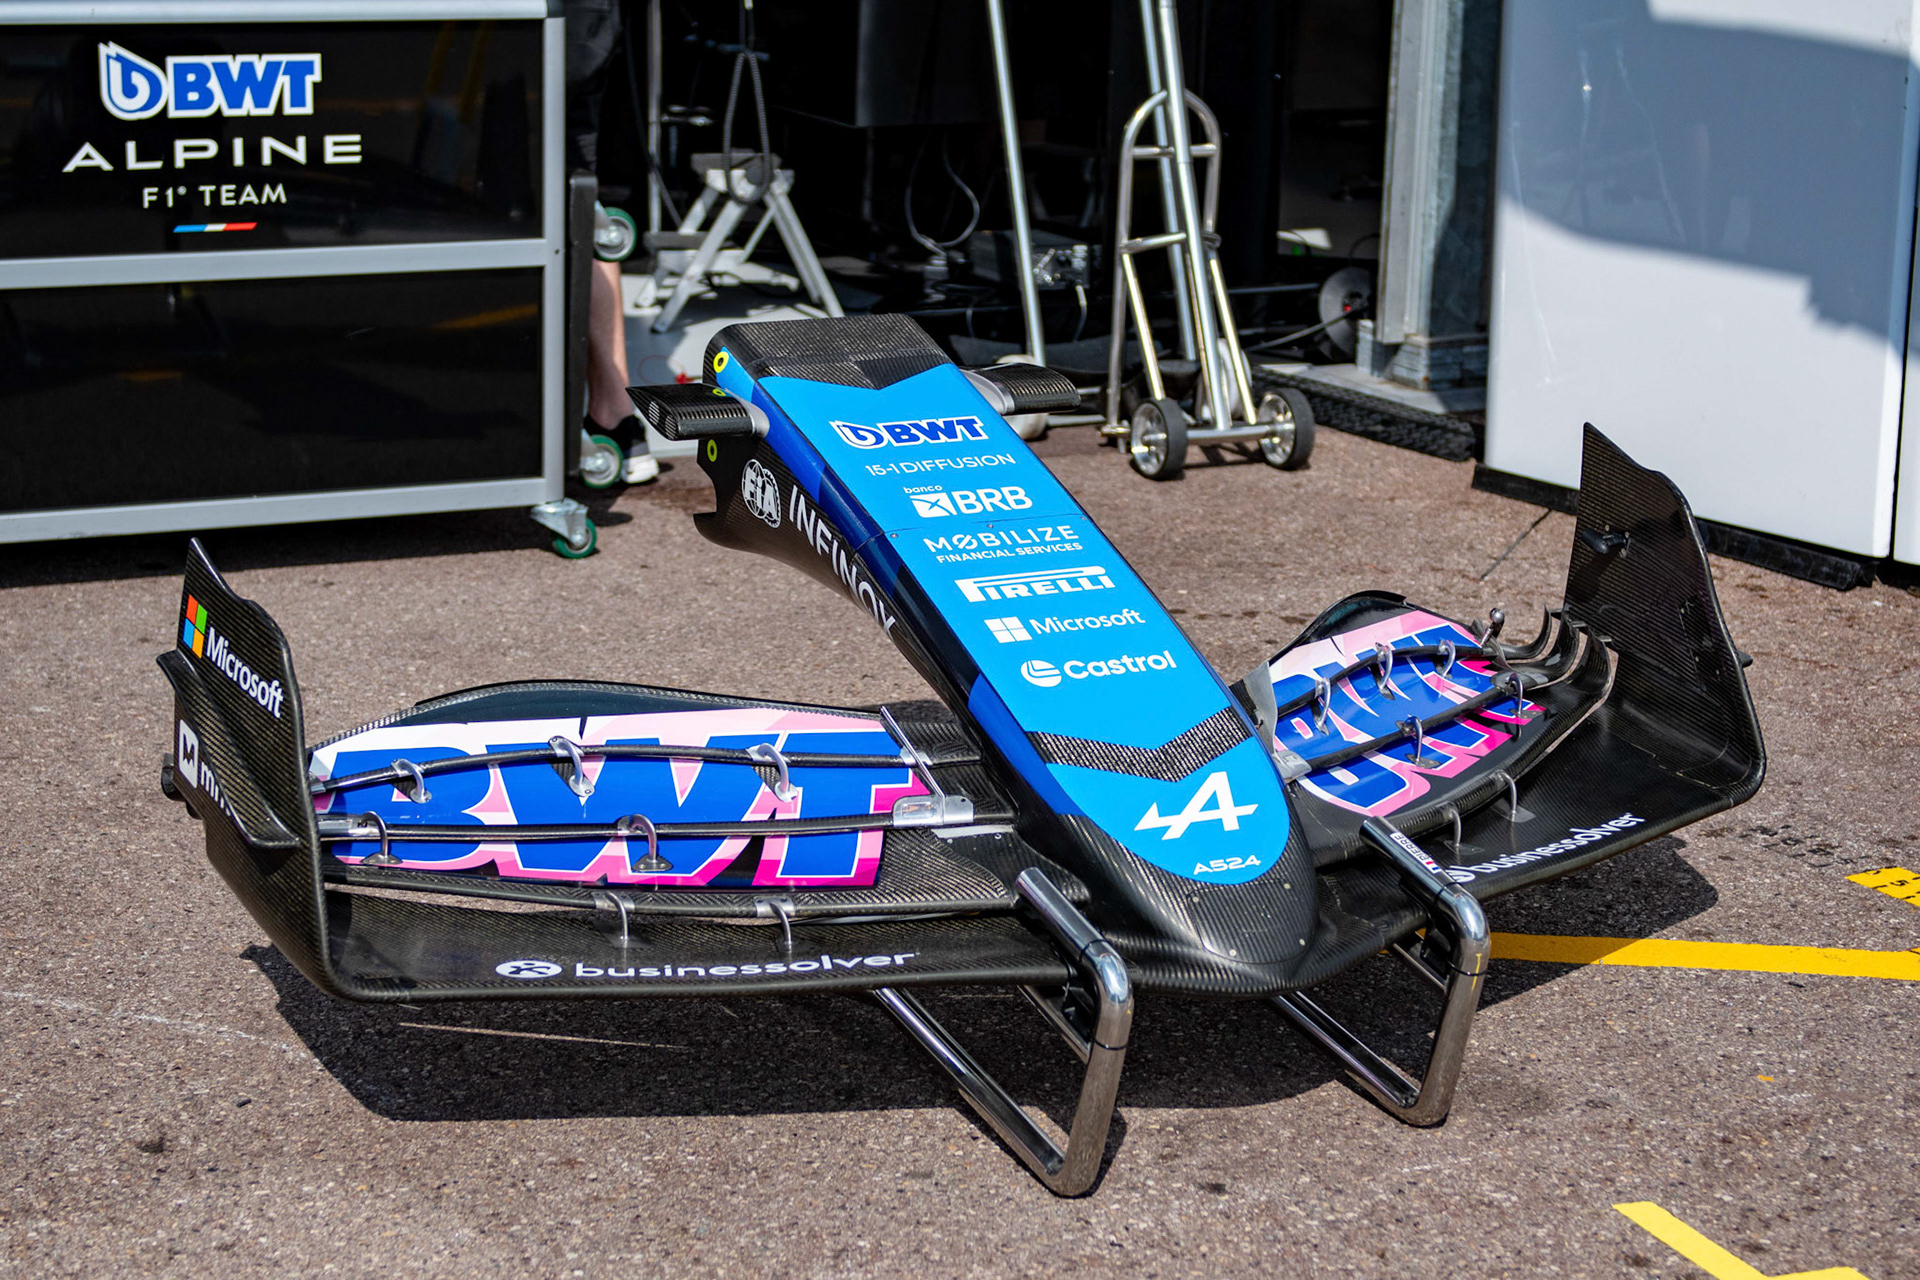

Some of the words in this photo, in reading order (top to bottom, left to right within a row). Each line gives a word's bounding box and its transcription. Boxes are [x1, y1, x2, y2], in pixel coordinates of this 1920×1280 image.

[166, 53, 321, 118] BWT
[62, 134, 362, 172] ALPINE
[198, 183, 287, 206] TEAM
[881, 416, 989, 447] BWT
[899, 453, 1016, 474] DIFFUSION
[903, 485, 943, 494] banco
[951, 486, 1033, 515] BRB
[936, 545, 1016, 563] FINANCIAL
[1015, 542, 1083, 556] SERVICES
[954, 565, 1116, 603] PIRELLI
[1029, 609, 1146, 635] Microsoft
[206, 626, 284, 719] Microsoft
[1063, 650, 1177, 679] Castrol
[325, 728, 912, 880] BWT
[1466, 813, 1646, 874] businessolver
[1193, 855, 1261, 875] A524
[575, 951, 917, 979] businessolver
